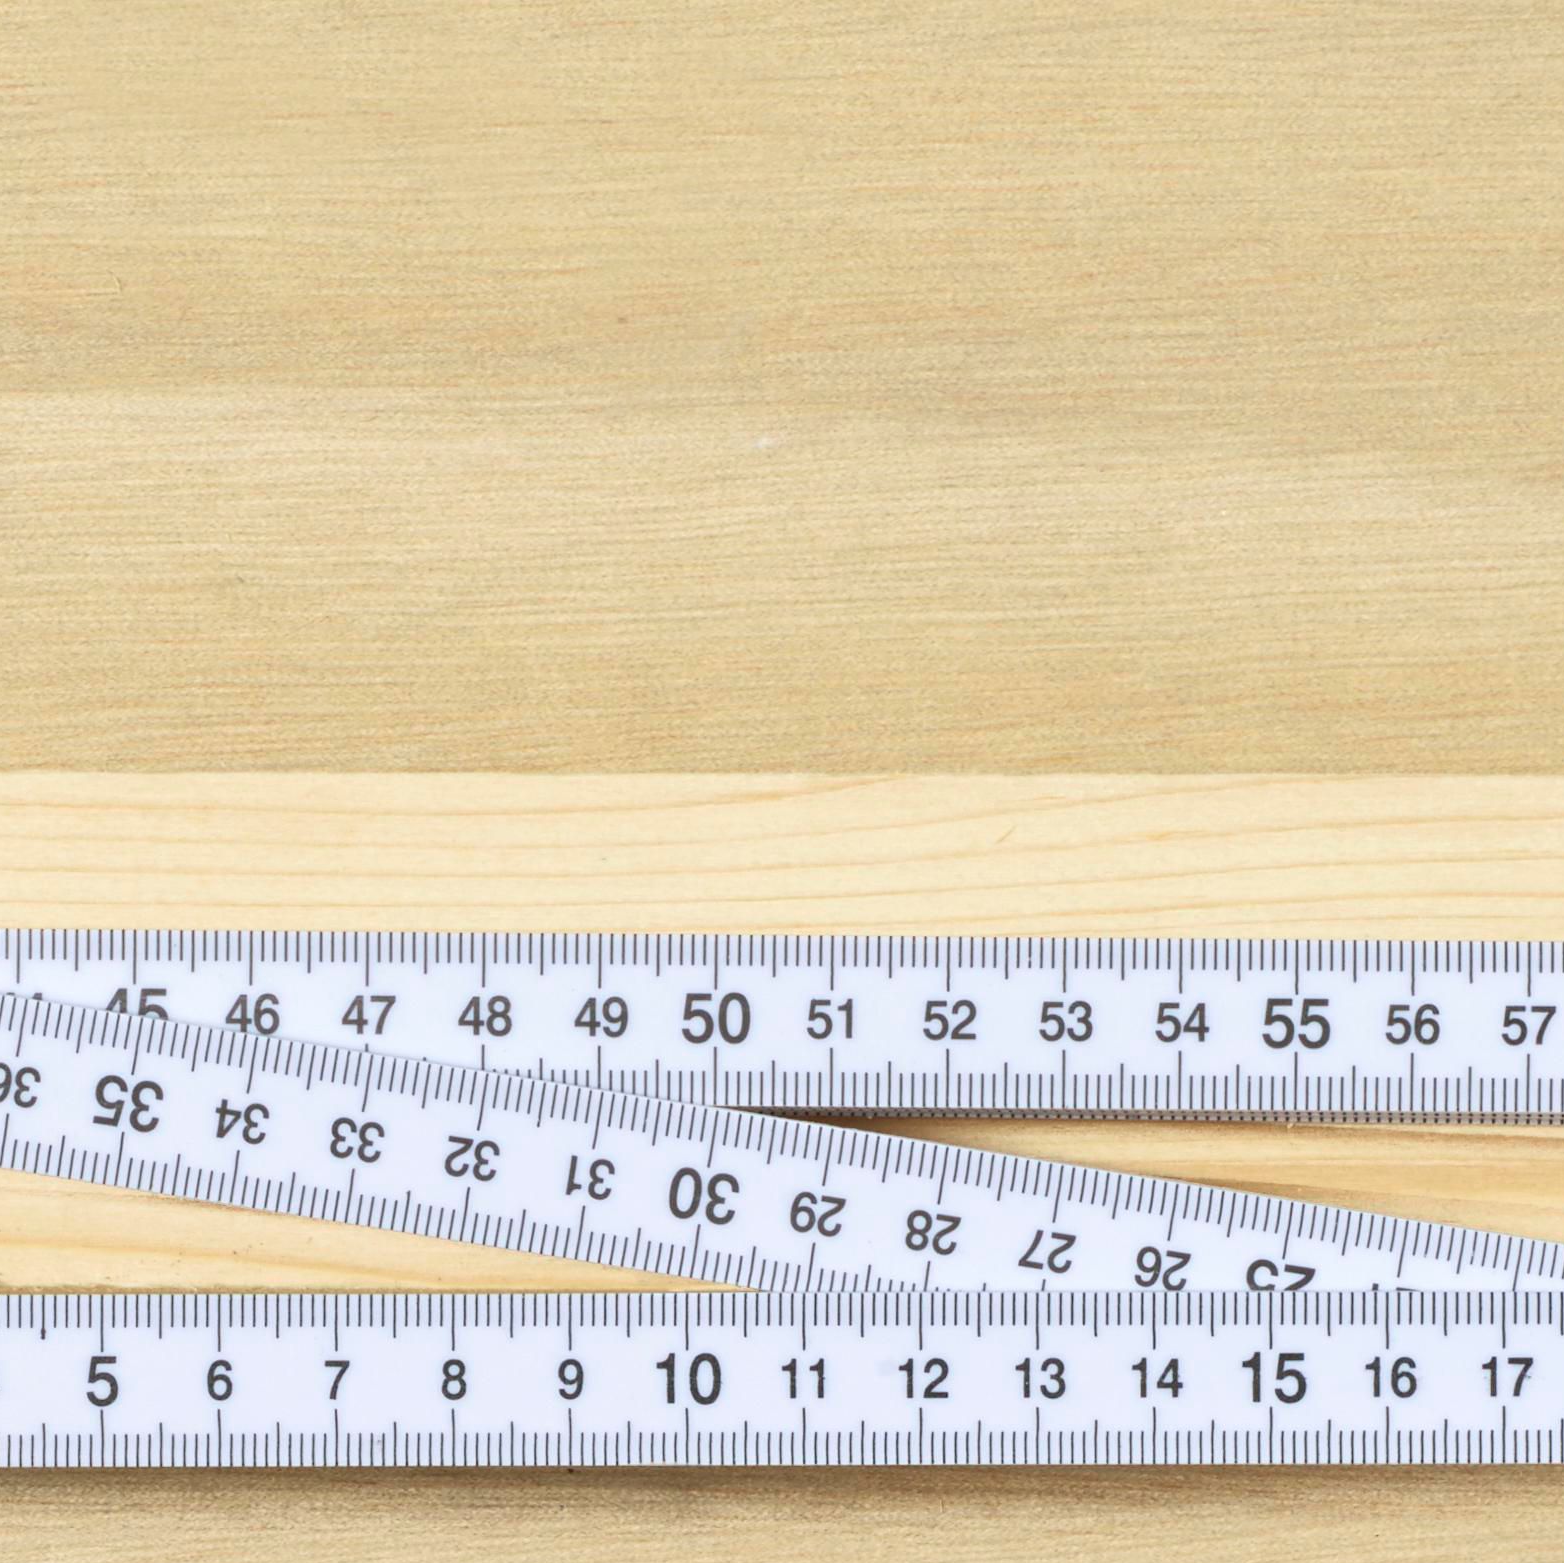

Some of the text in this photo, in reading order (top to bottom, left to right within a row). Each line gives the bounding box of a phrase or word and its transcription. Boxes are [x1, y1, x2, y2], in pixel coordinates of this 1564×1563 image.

[225, 993, 280, 1036] 46
[341, 995, 396, 1035] 47
[458, 996, 512, 1037] 48
[574, 996, 628, 1038] 49
[682, 992, 751, 1045] 50
[807, 999, 853, 1040] 51
[923, 1000, 977, 1041] 52
[1039, 1001, 1093, 1042] 53
[1155, 1002, 1210, 1043] 54
[1262, 998, 1331, 1049] 55
[1385, 1003, 1440, 1045] 56
[1501, 1005, 1556, 1046] 57
[93, 1075, 164, 1133] 35
[215, 1099, 270, 1145] 34
[330, 1117, 385, 1163] 33
[444, 1135, 500, 1182] 32
[566, 1155, 615, 1201] 31
[669, 1167, 740, 1225] 30
[790, 1191, 846, 1237] 29
[905, 1209, 962, 1256] 28
[1018, 1230, 1076, 1274] 27
[1134, 1246, 1191, 1292] 26
[86, 1355, 119, 1407] 5
[207, 1359, 233, 1401] 6
[324, 1360, 350, 1400] 7
[441, 1359, 467, 1401] 8
[558, 1358, 584, 1400] 9
[656, 1352, 722, 1406] 10
[781, 1358, 825, 1399] 11
[898, 1358, 949, 1399] 12
[1015, 1357, 1066, 1400] 13
[1131, 1357, 1183, 1398] 14
[1242, 1351, 1307, 1404] 15
[1365, 1356, 1417, 1399] 16
[1481, 1356, 1534, 1397] 17
